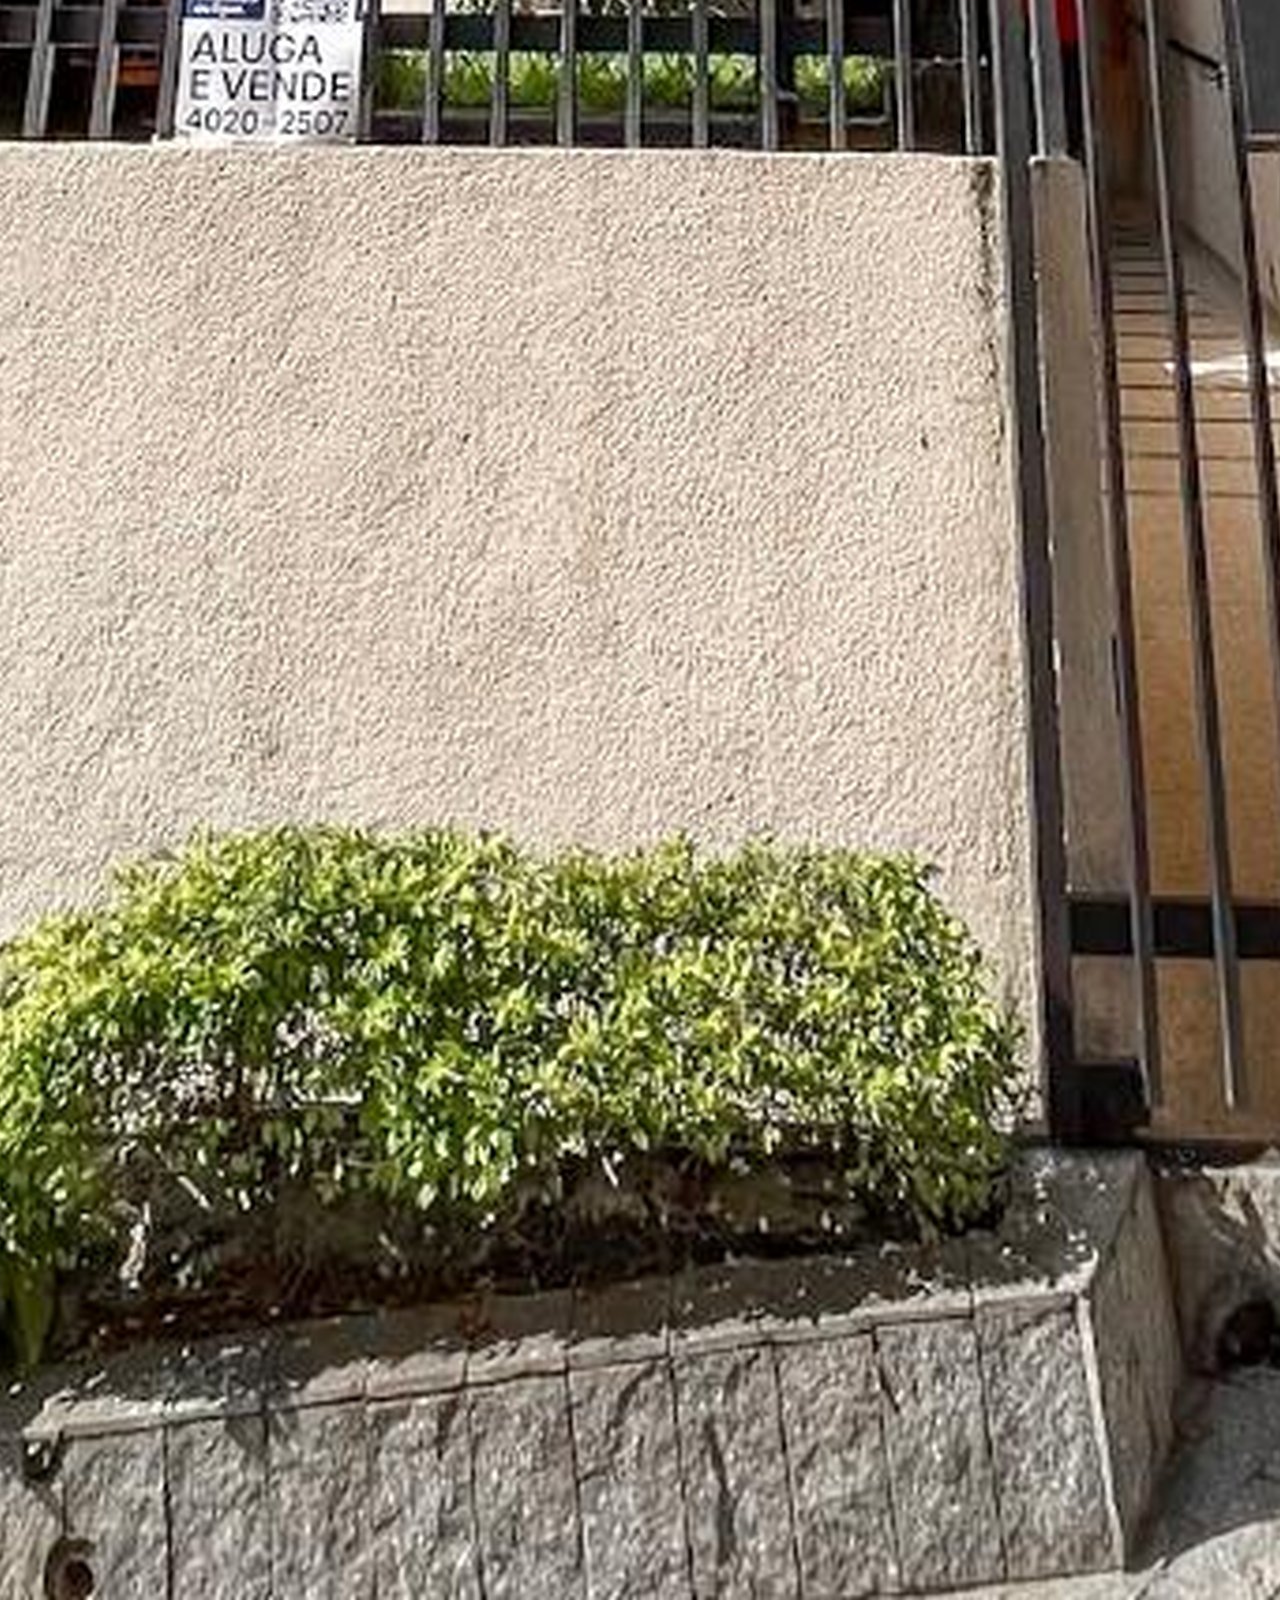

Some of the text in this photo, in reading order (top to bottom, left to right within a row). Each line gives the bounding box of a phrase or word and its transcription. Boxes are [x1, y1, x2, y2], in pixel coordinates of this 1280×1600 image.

[190, 31, 323, 64] ALUGA
[190, 69, 352, 102] E VENDE
